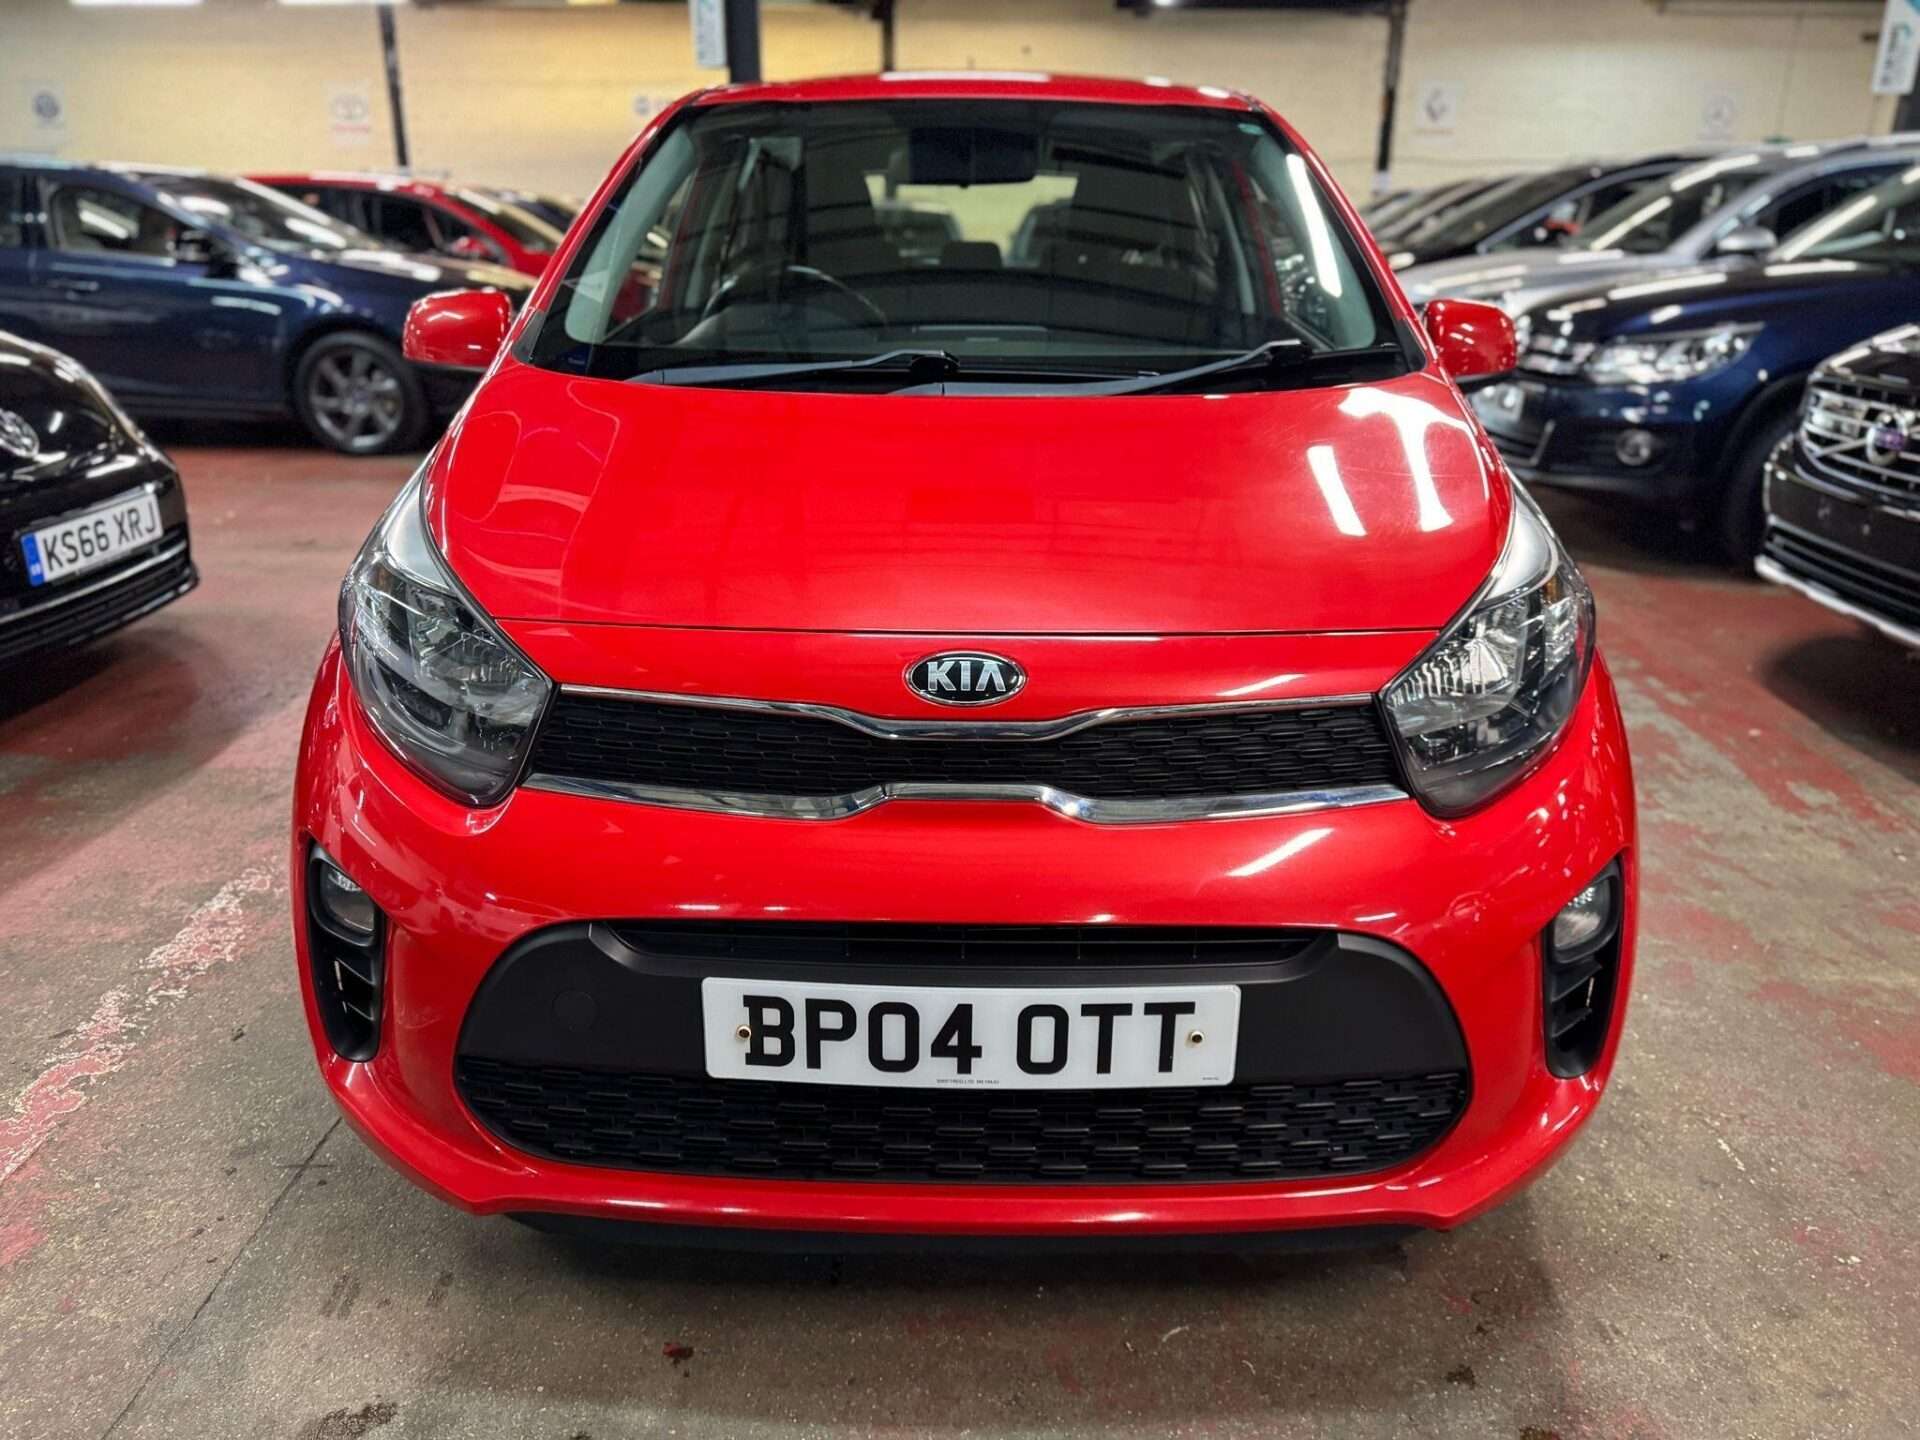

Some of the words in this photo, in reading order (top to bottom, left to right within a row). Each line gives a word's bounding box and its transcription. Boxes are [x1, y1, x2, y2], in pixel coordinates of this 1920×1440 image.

[43, 520, 110, 572] KS66
[113, 502, 157, 545] XRJ
[927, 660, 1006, 691] KIA
[742, 994, 983, 1075] BP04
[1016, 1001, 1197, 1075] OTT
